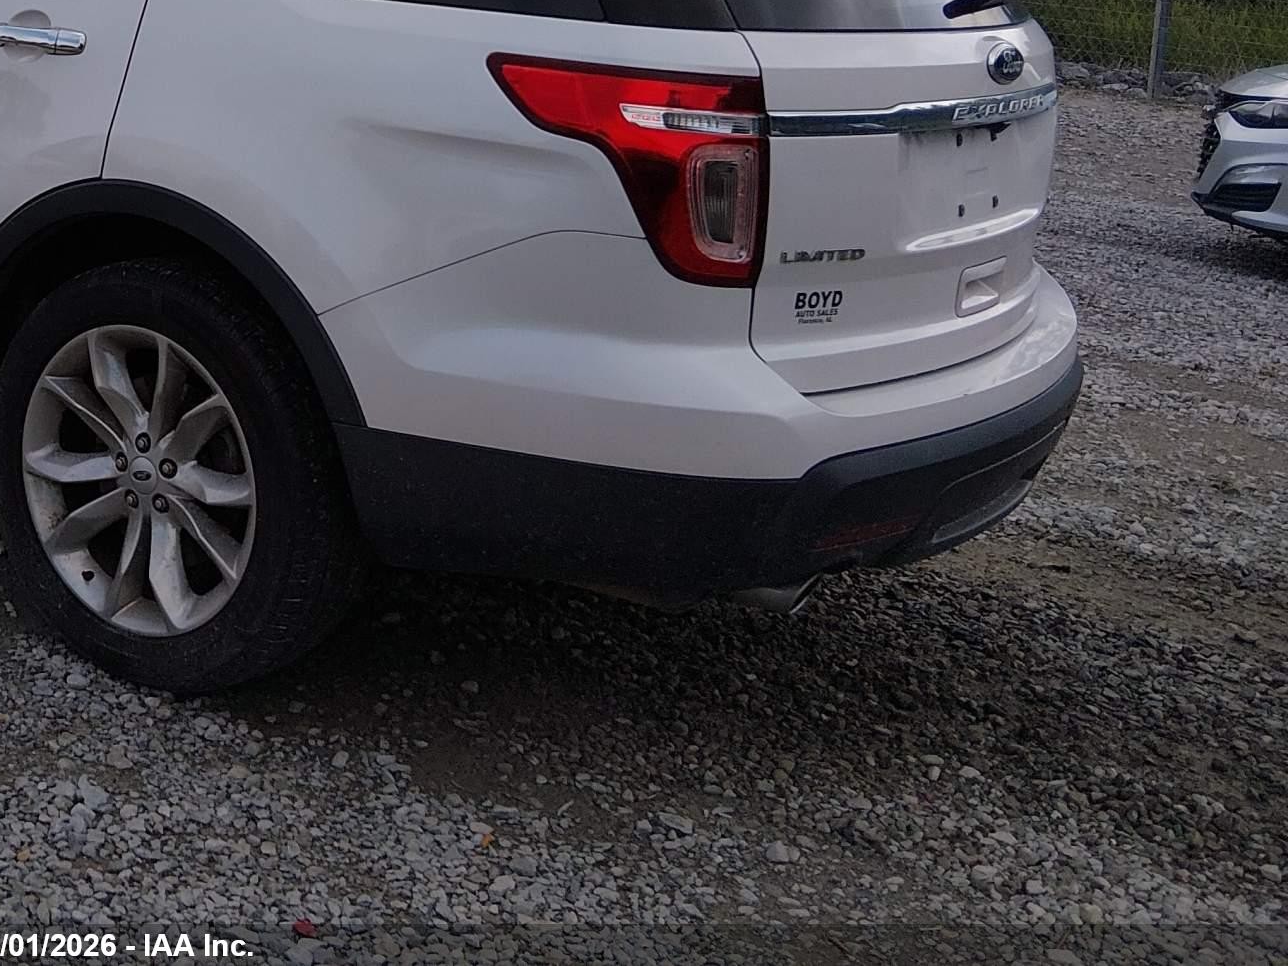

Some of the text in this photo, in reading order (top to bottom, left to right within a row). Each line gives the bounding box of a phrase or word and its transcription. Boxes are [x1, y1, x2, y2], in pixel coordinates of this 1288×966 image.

[952, 95, 1043, 121] EXPLORER
[779, 249, 865, 264] LIMITED
[794, 290, 843, 310] BOYD
[795, 308, 838, 318] AUTO SALES
